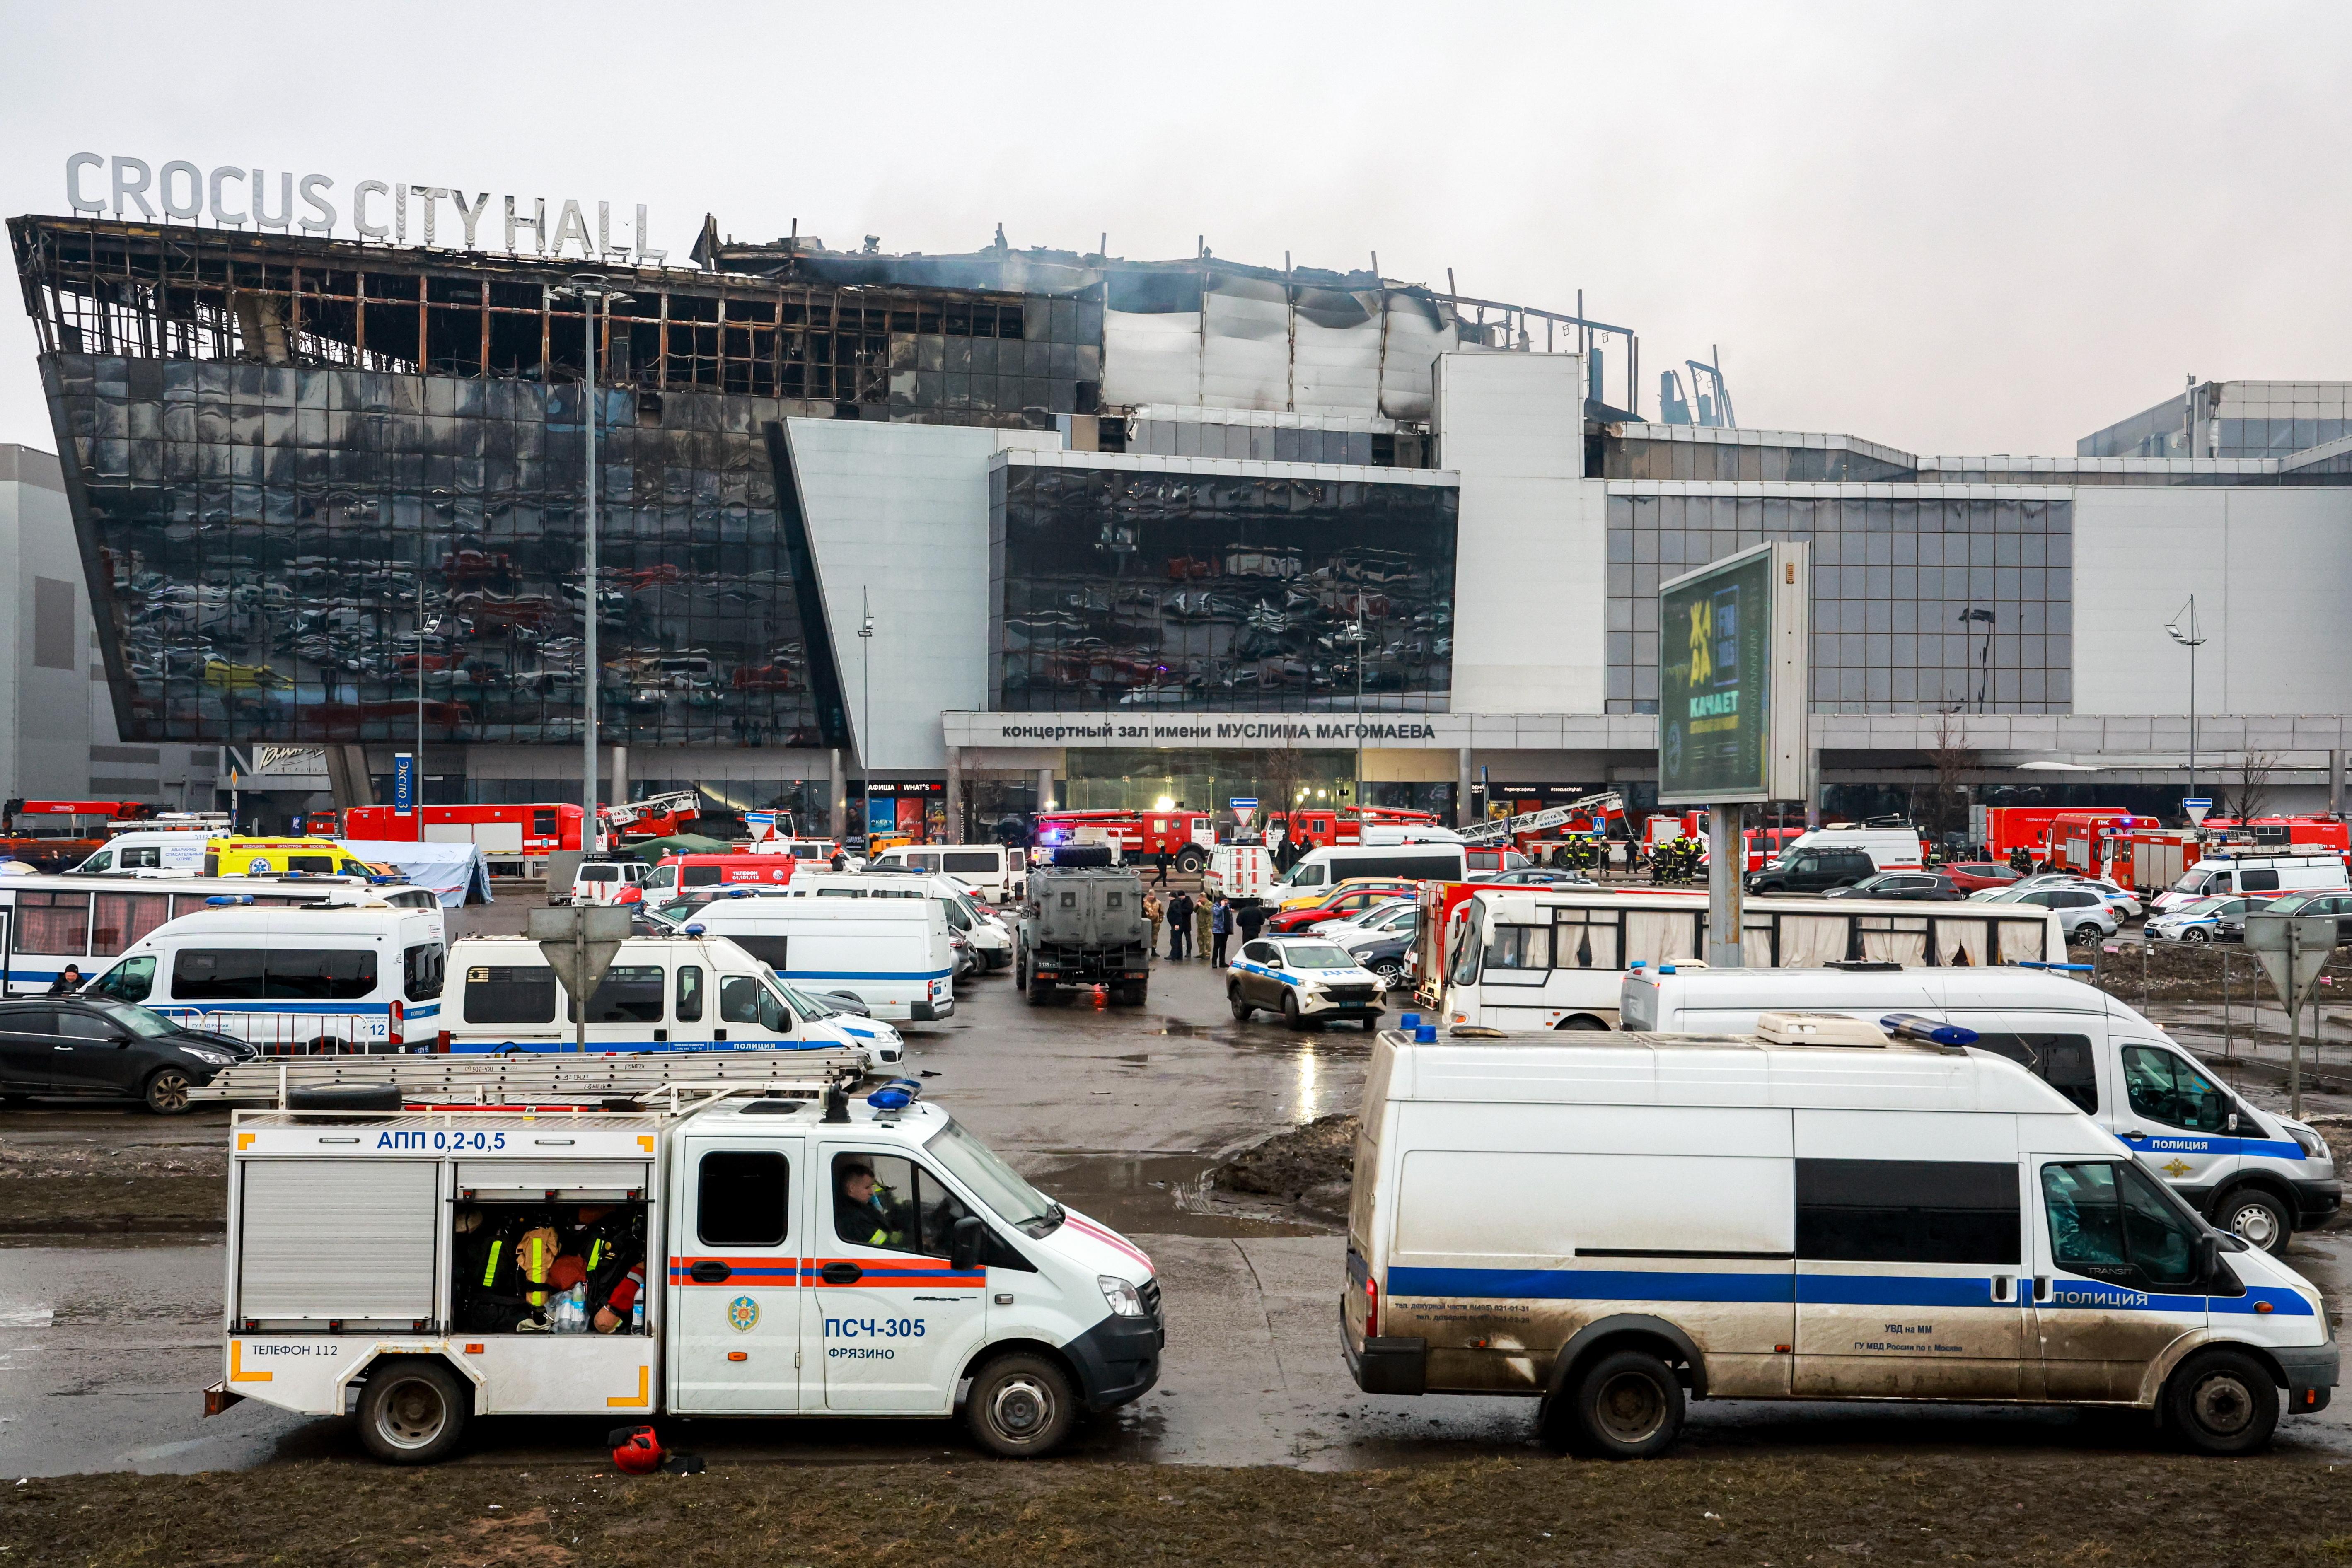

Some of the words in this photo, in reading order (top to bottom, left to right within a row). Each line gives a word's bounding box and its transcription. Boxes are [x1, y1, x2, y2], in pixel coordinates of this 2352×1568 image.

[66, 152, 337, 232] CROCUS
[354, 180, 490, 245] CITY
[505, 195, 668, 259] HALL
[1690, 691, 1739, 718] КАЧАЕТ
[1002, 722, 1112, 740] концертный
[1118, 725, 1148, 737] зал
[1155, 725, 1211, 737] имени
[1217, 723, 1310, 739] МУСЛИМА
[1317, 723, 1435, 739] МАГОМАЕВА
[398, 761, 409, 798] ЭКСПО
[1540, 819, 1563, 827] MAGIRUS
[363, 1024, 384, 1035] 12
[377, 1131, 425, 1149] АПП
[434, 1131, 505, 1152] 0,2-0,5
[2152, 1139, 2208, 1151] ПОЛИЦИЯ
[2053, 1291, 2148, 1307] ПОЛИЦИЯ
[824, 1317, 926, 1338] ПСЧ-305
[1885, 1324, 1903, 1334] УВД
[253, 1345, 312, 1355] ТЕЛЕФОН
[314, 1345, 338, 1356] 112
[829, 1347, 894, 1360] ФРЯЗИНО
[1866, 1342, 1884, 1351] МВД
